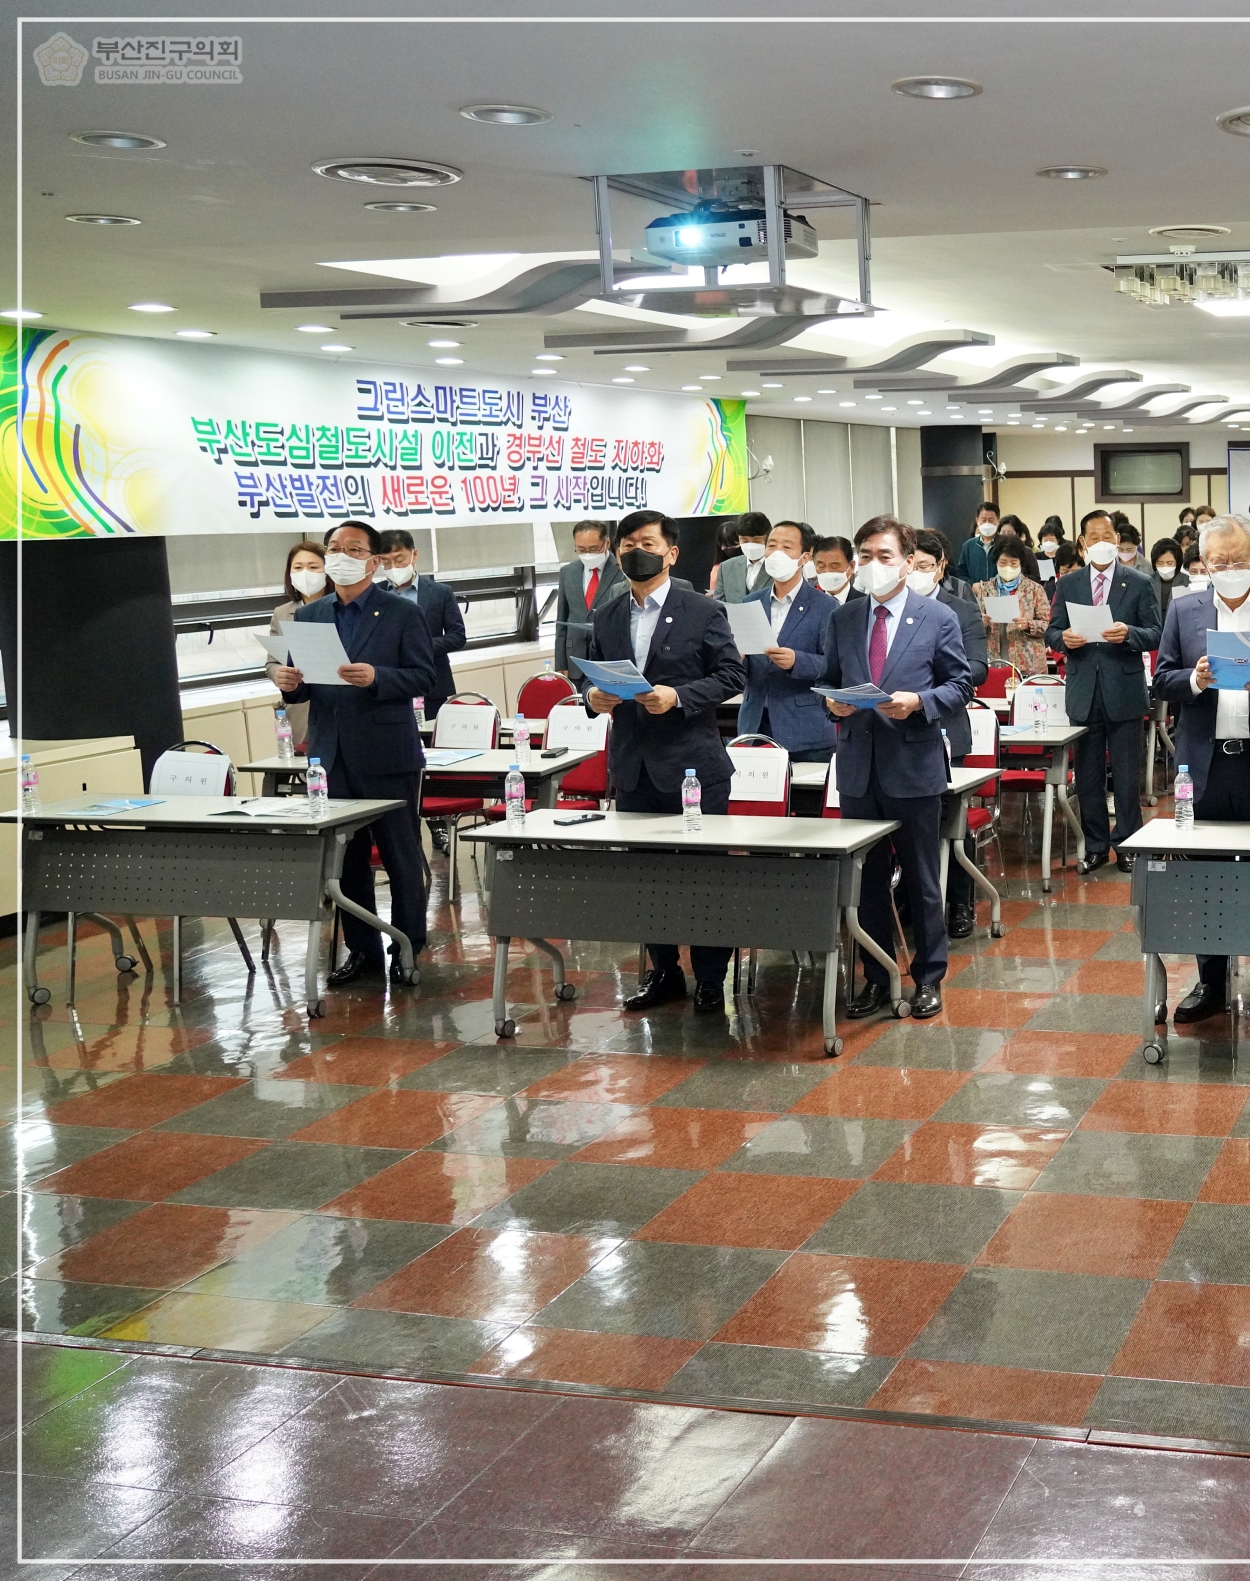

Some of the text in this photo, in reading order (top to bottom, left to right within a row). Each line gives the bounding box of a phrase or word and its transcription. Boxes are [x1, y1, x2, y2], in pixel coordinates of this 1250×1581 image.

[356, 379, 570, 428] 그린스마트도시 부산
[190, 416, 664, 471] 부산도심철도시설 이전과 경부선 철도 지하화
[234, 471, 647, 516] 부산발전의 새로운 100년, 그 시작입니다!
